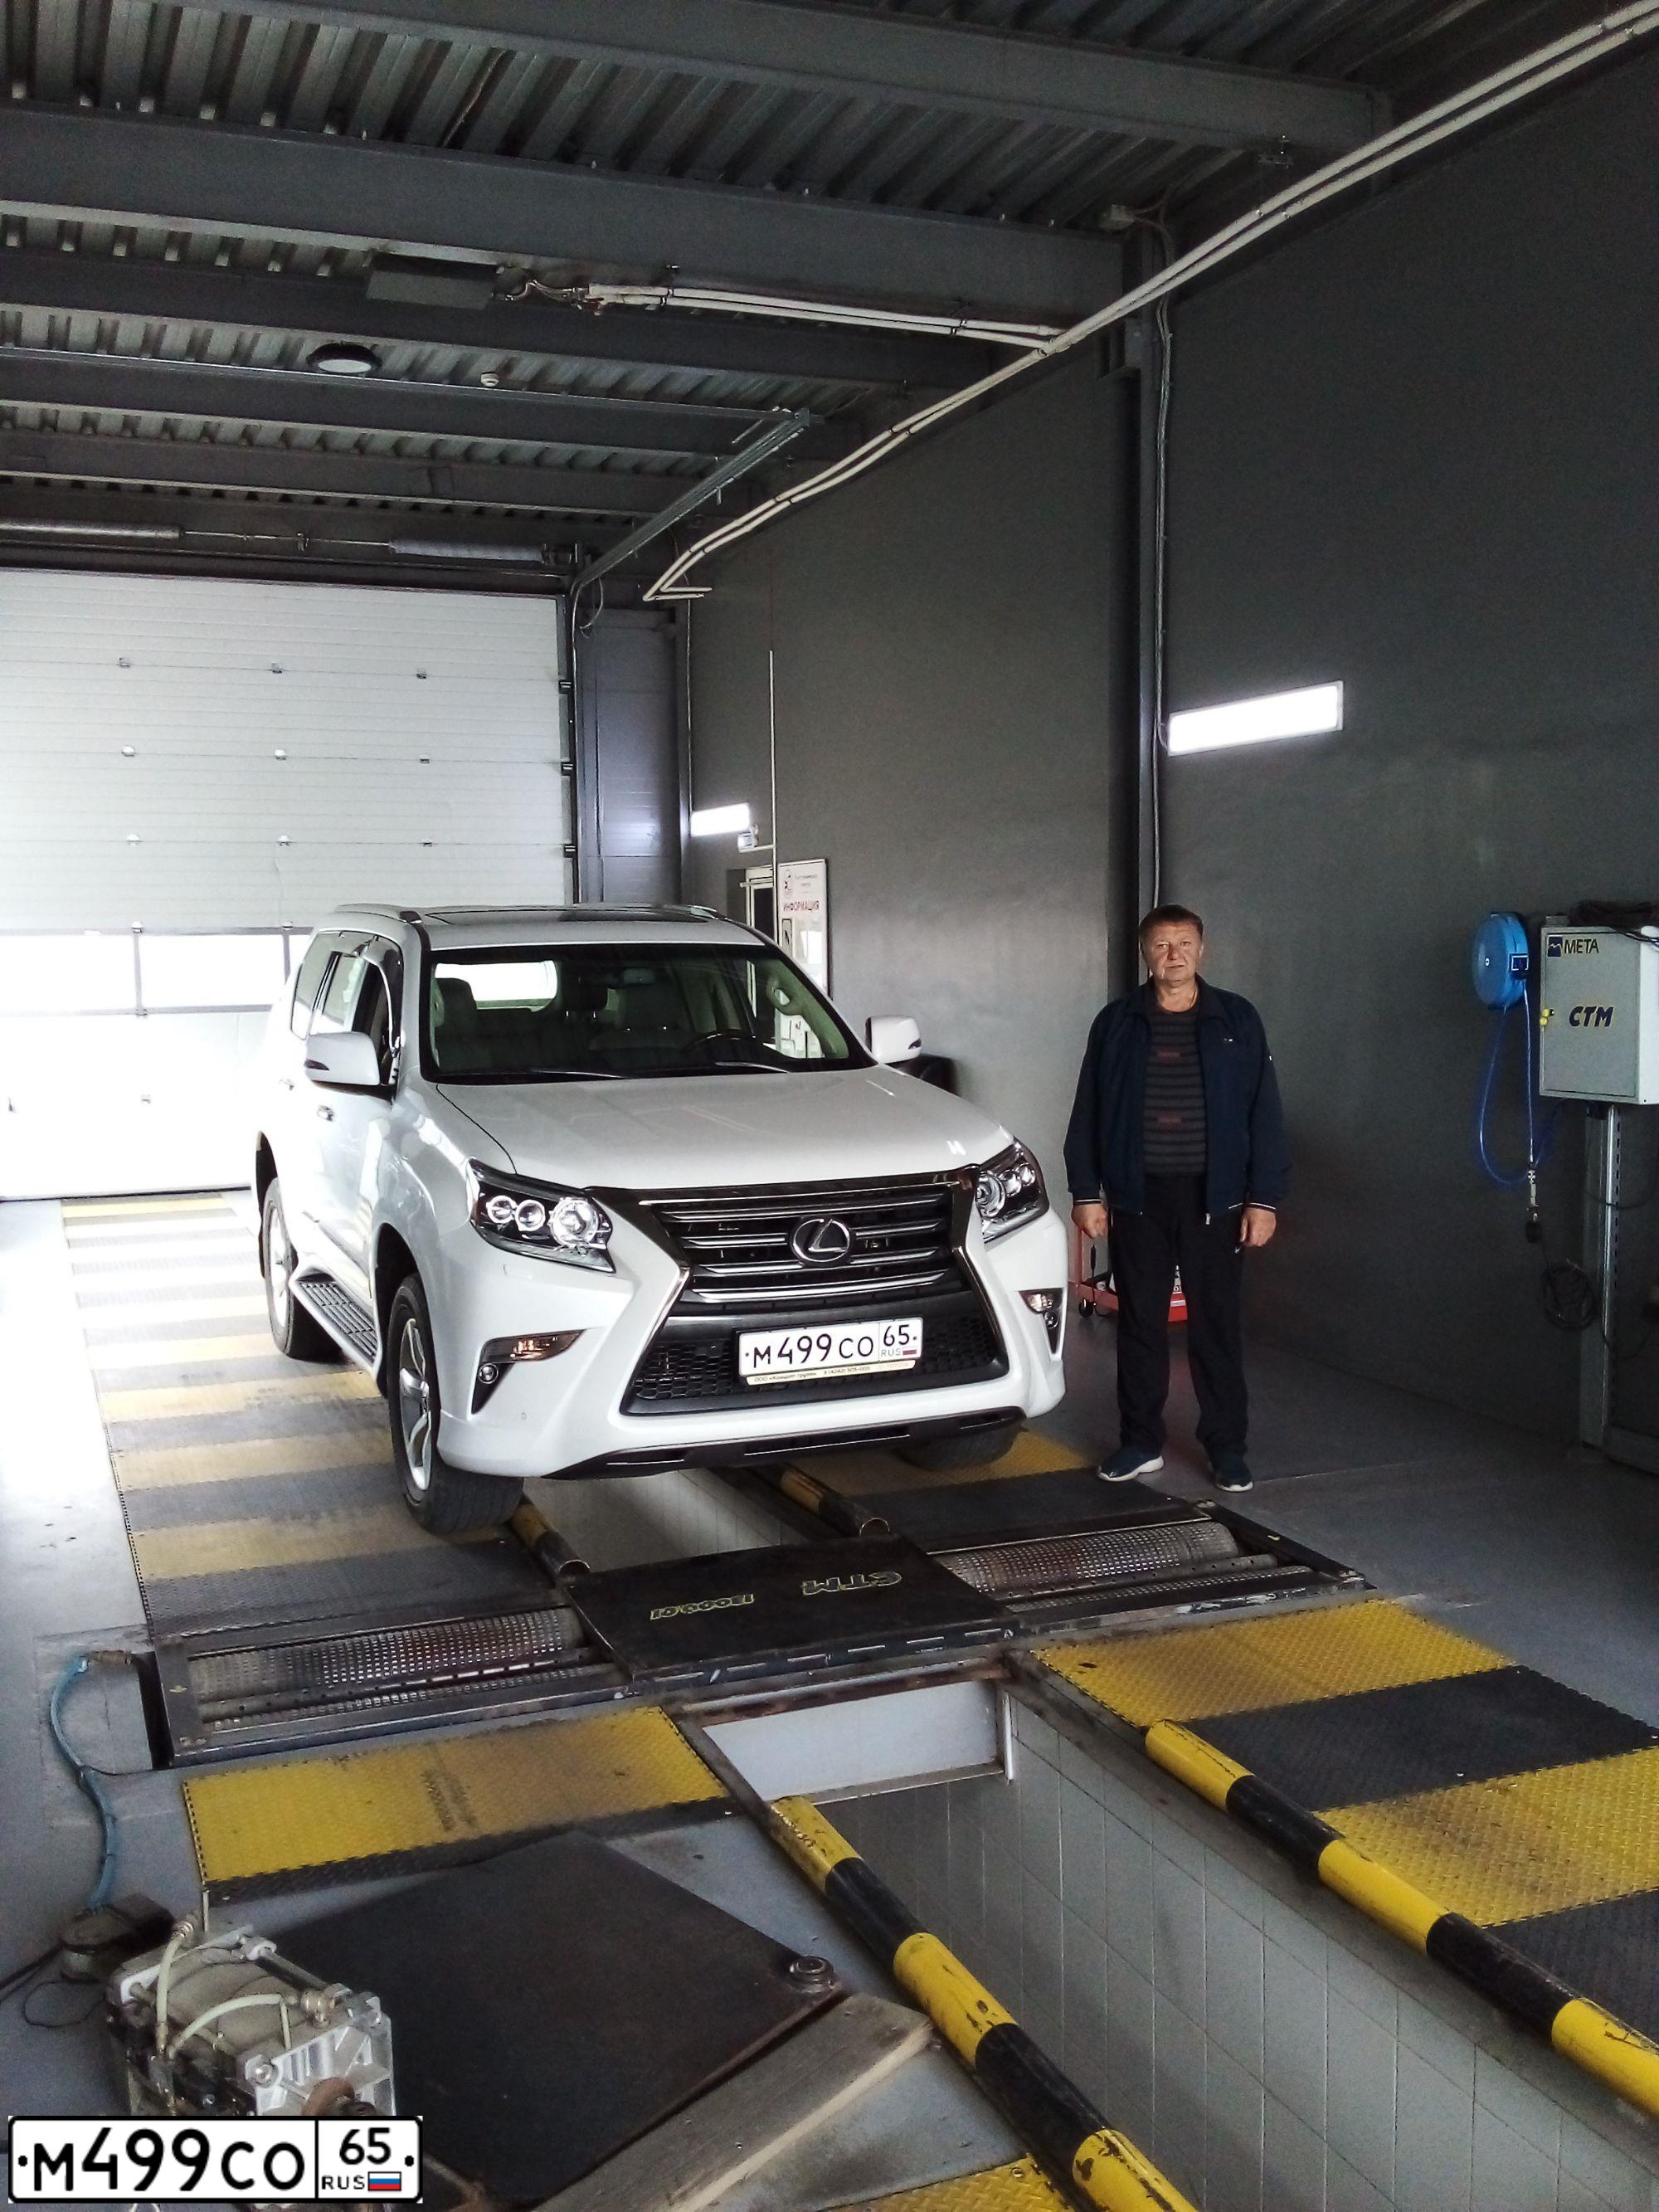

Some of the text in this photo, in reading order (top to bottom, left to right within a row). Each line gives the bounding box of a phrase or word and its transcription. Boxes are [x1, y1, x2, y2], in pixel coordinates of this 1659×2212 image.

[783, 900, 820, 912] ИНФОРМАЦИЯ
[883, 1324, 911, 1347] 65
[880, 1347, 901, 1357] RUS
